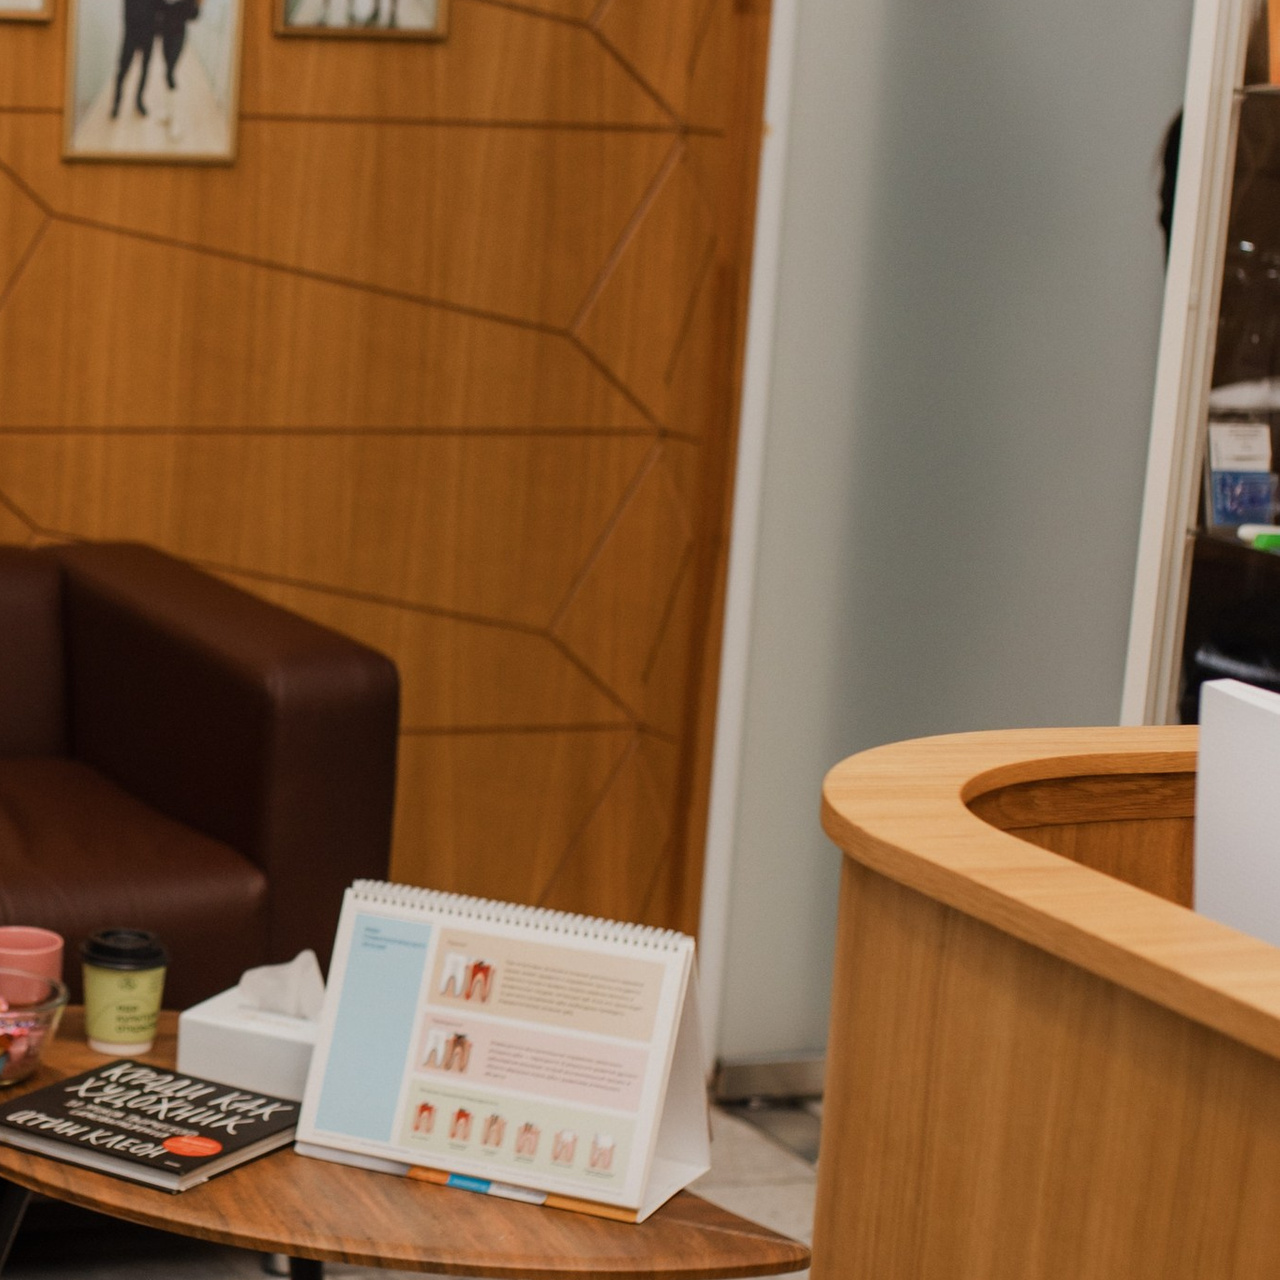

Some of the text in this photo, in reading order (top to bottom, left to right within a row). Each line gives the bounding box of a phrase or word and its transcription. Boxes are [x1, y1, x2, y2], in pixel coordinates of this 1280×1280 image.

[64, 1076, 256, 1136] ХУДОЖНИК
[100, 1062, 217, 1101] КРАДИ
[208, 1091, 295, 1122] КАК
[79, 1128, 169, 1159] КЛЕОН
